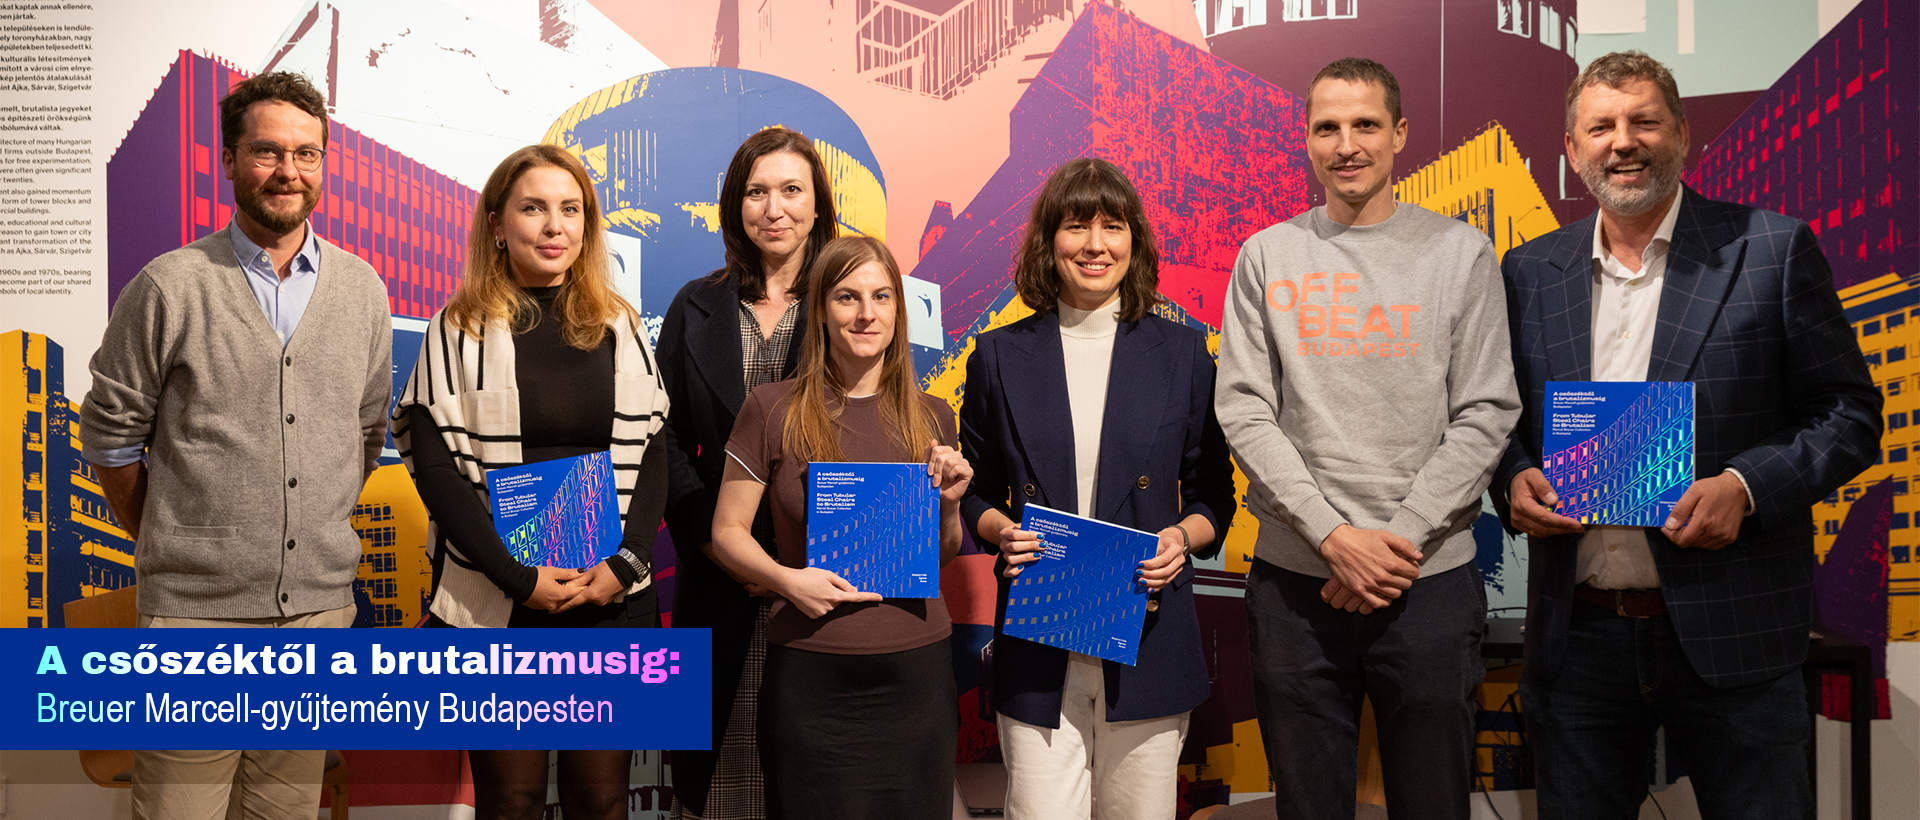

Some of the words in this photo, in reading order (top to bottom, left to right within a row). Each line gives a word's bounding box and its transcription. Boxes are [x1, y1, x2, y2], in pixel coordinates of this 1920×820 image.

[15, 3, 39, 11] kaptak
[12, 13, 36, 21] jártak.
[3, 25, 55, 33] településeken
[12, 34, 73, 42] toronyházakban,
[70, 65, 93, 73] elnye-
[12, 83, 30, 92] Ajka,
[58, 84, 92, 92] Szigetvár
[59, 105, 91, 113] jegyeket
[35, 167, 54, 175] given
[55, 167, 91, 175] significant
[17, 207, 50, 215] buildings.
[60, 247, 92, 255] Szigetvár
[64, 269, 91, 277] bearing
[1266, 272, 1360, 312] OFF
[1299, 304, 1420, 339] BEAT
[1297, 342, 1420, 357] BUDAPEST
